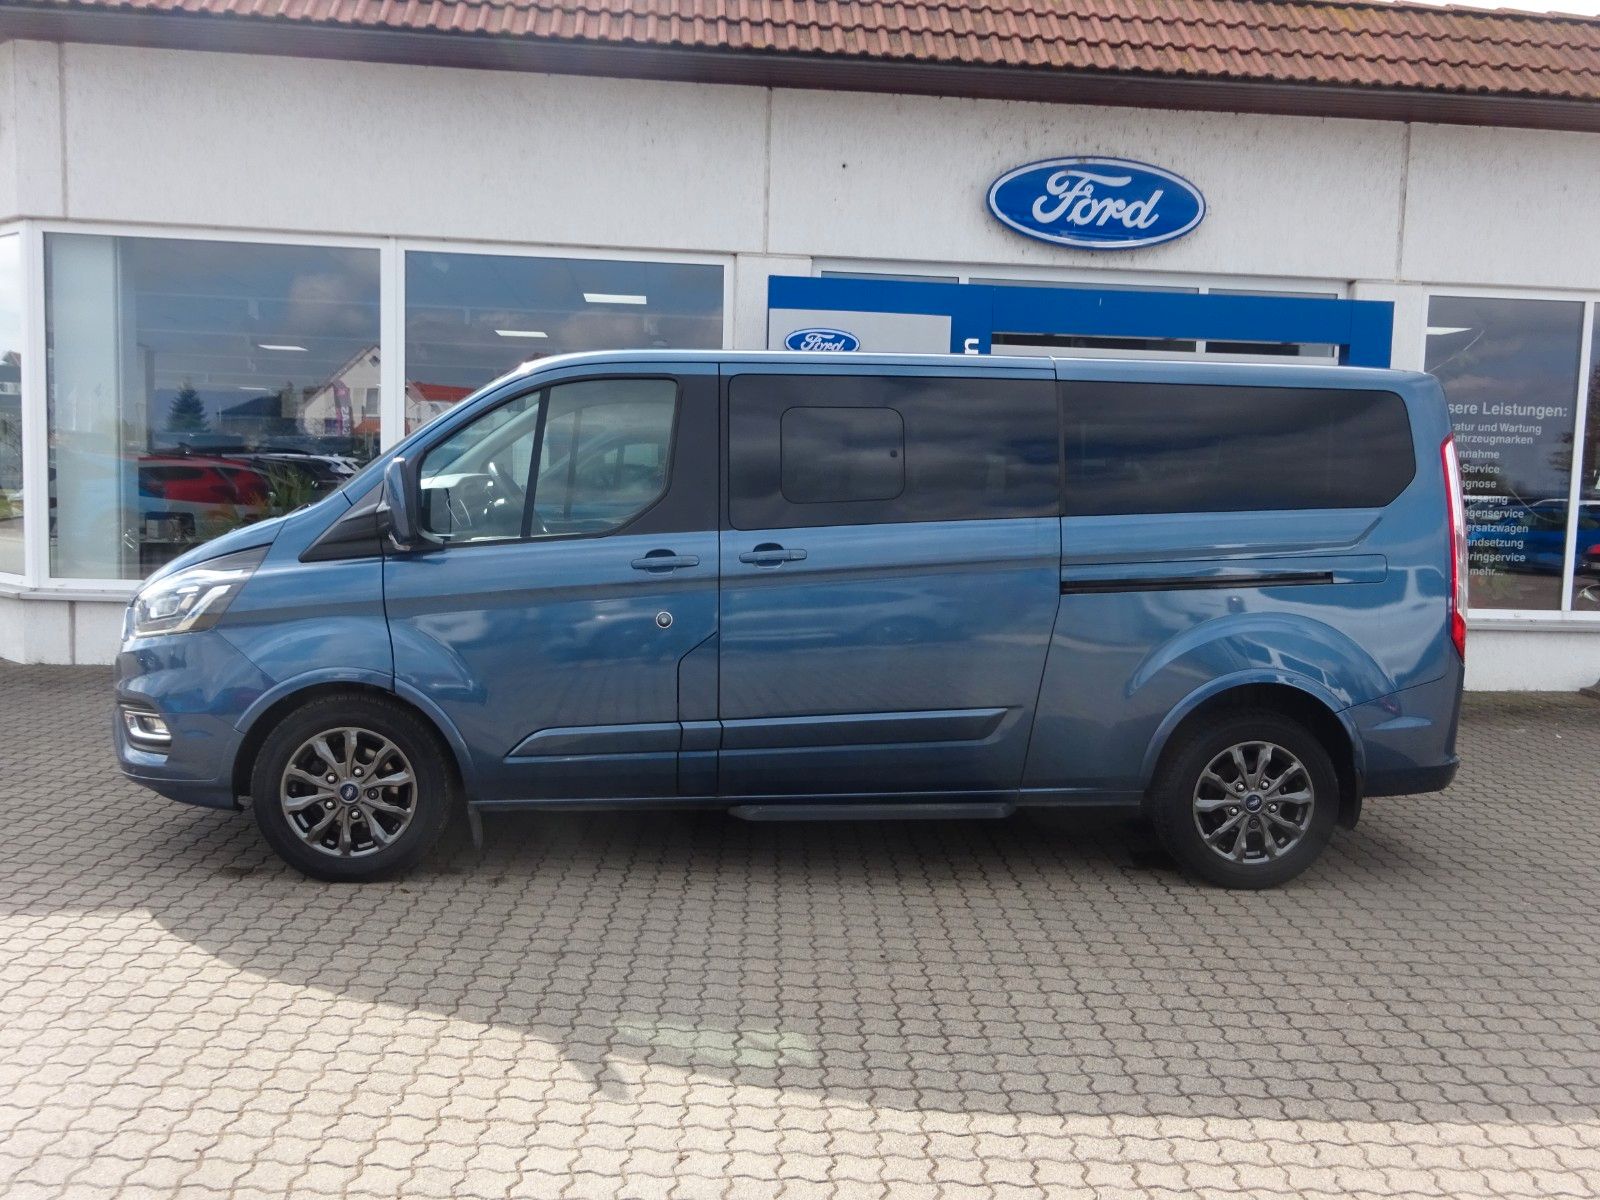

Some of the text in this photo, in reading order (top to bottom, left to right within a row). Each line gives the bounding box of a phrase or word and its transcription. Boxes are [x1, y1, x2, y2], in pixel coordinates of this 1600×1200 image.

[1032, 170, 1164, 229] Ford
[800, 333, 846, 351] Ford
[1482, 402, 1568, 419] Leistungen:
[1478, 423, 1497, 432] und
[1500, 423, 1542, 435] Wartung
